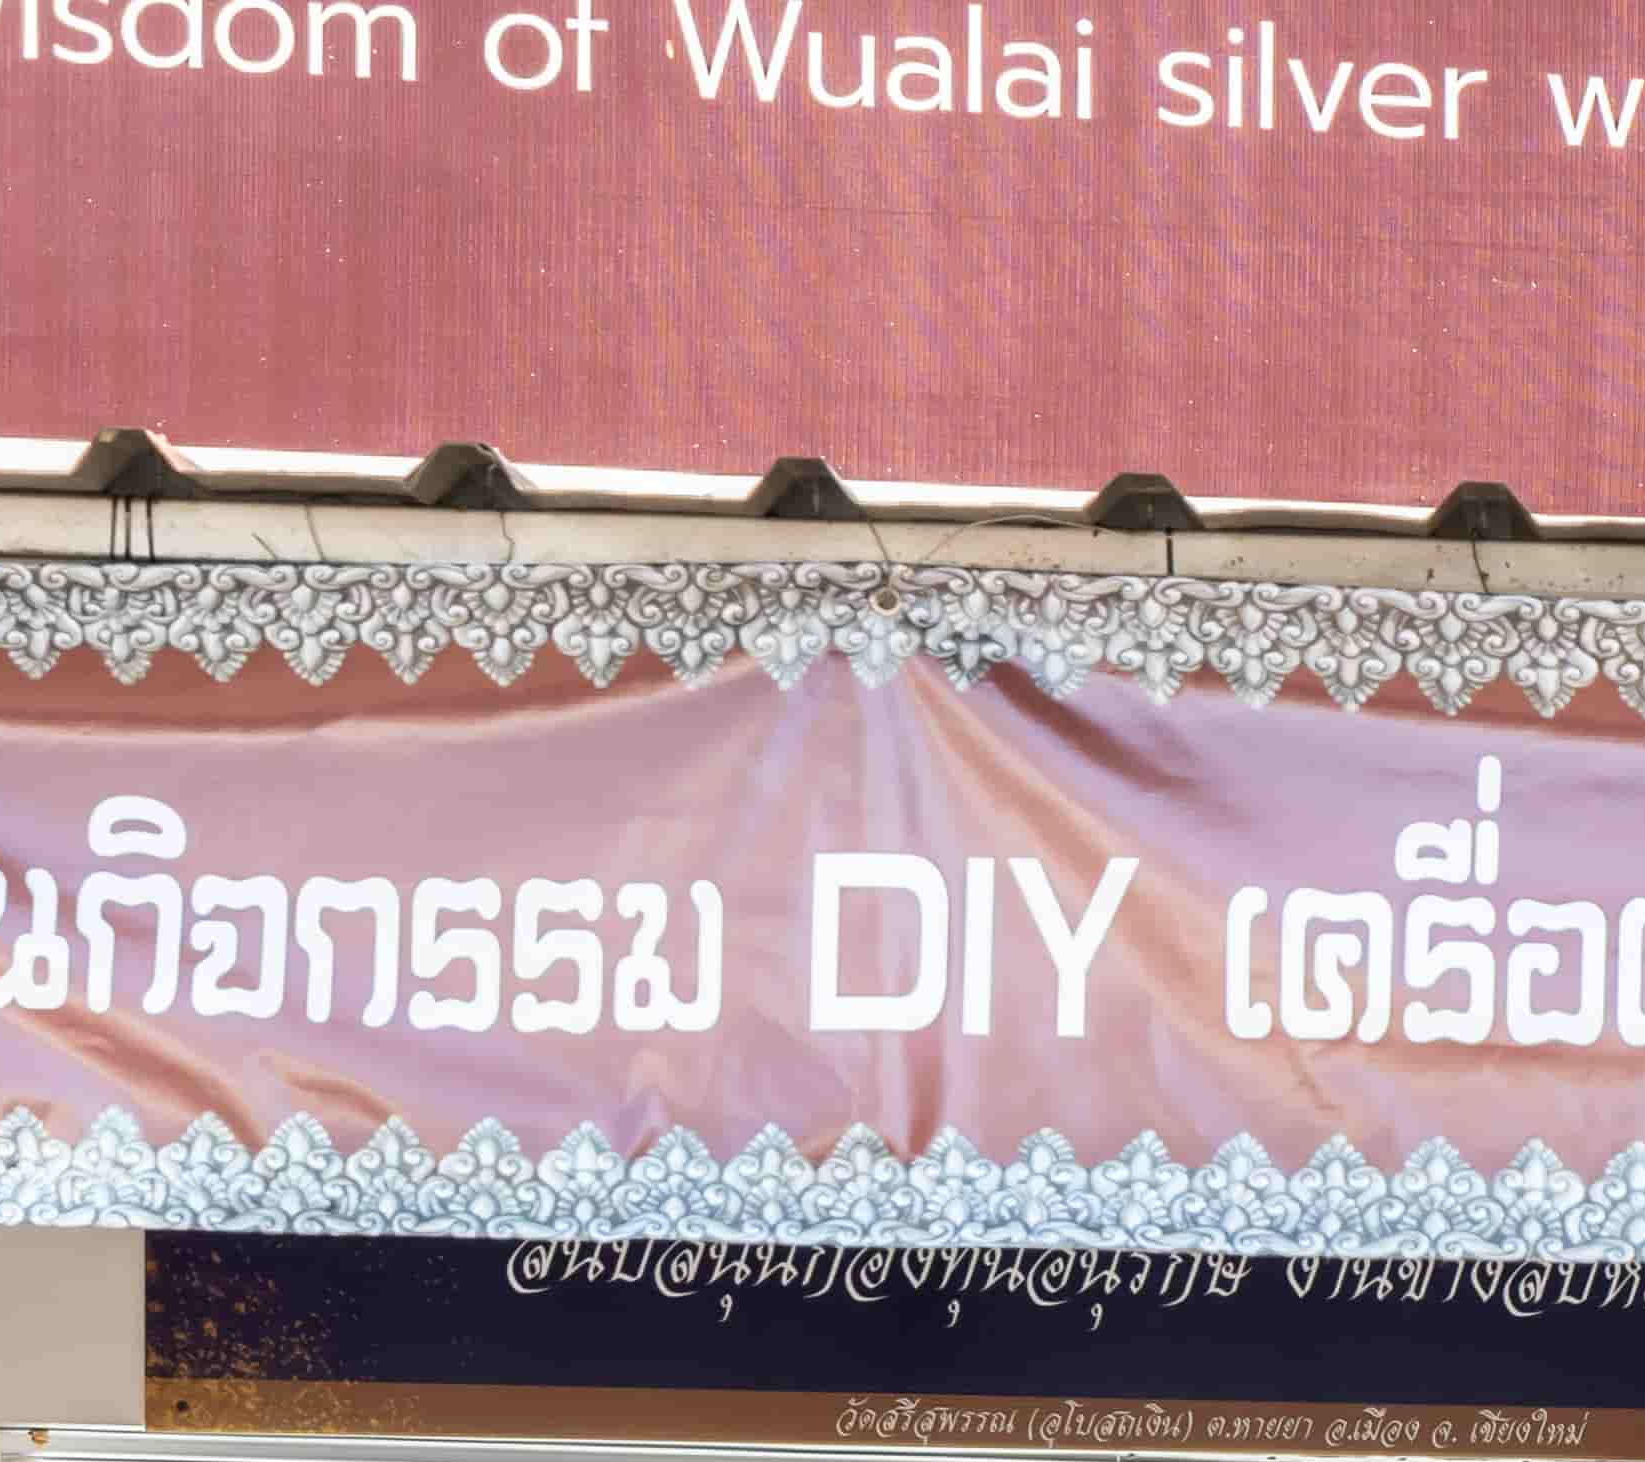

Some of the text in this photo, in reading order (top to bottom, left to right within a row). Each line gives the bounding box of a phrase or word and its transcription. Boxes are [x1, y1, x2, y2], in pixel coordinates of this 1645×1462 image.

[483, 0, 610, 92] of
[673, 0, 1095, 121] Wualai
[1157, 20, 1489, 141] silver
[808, 852, 1141, 1039] DIY
